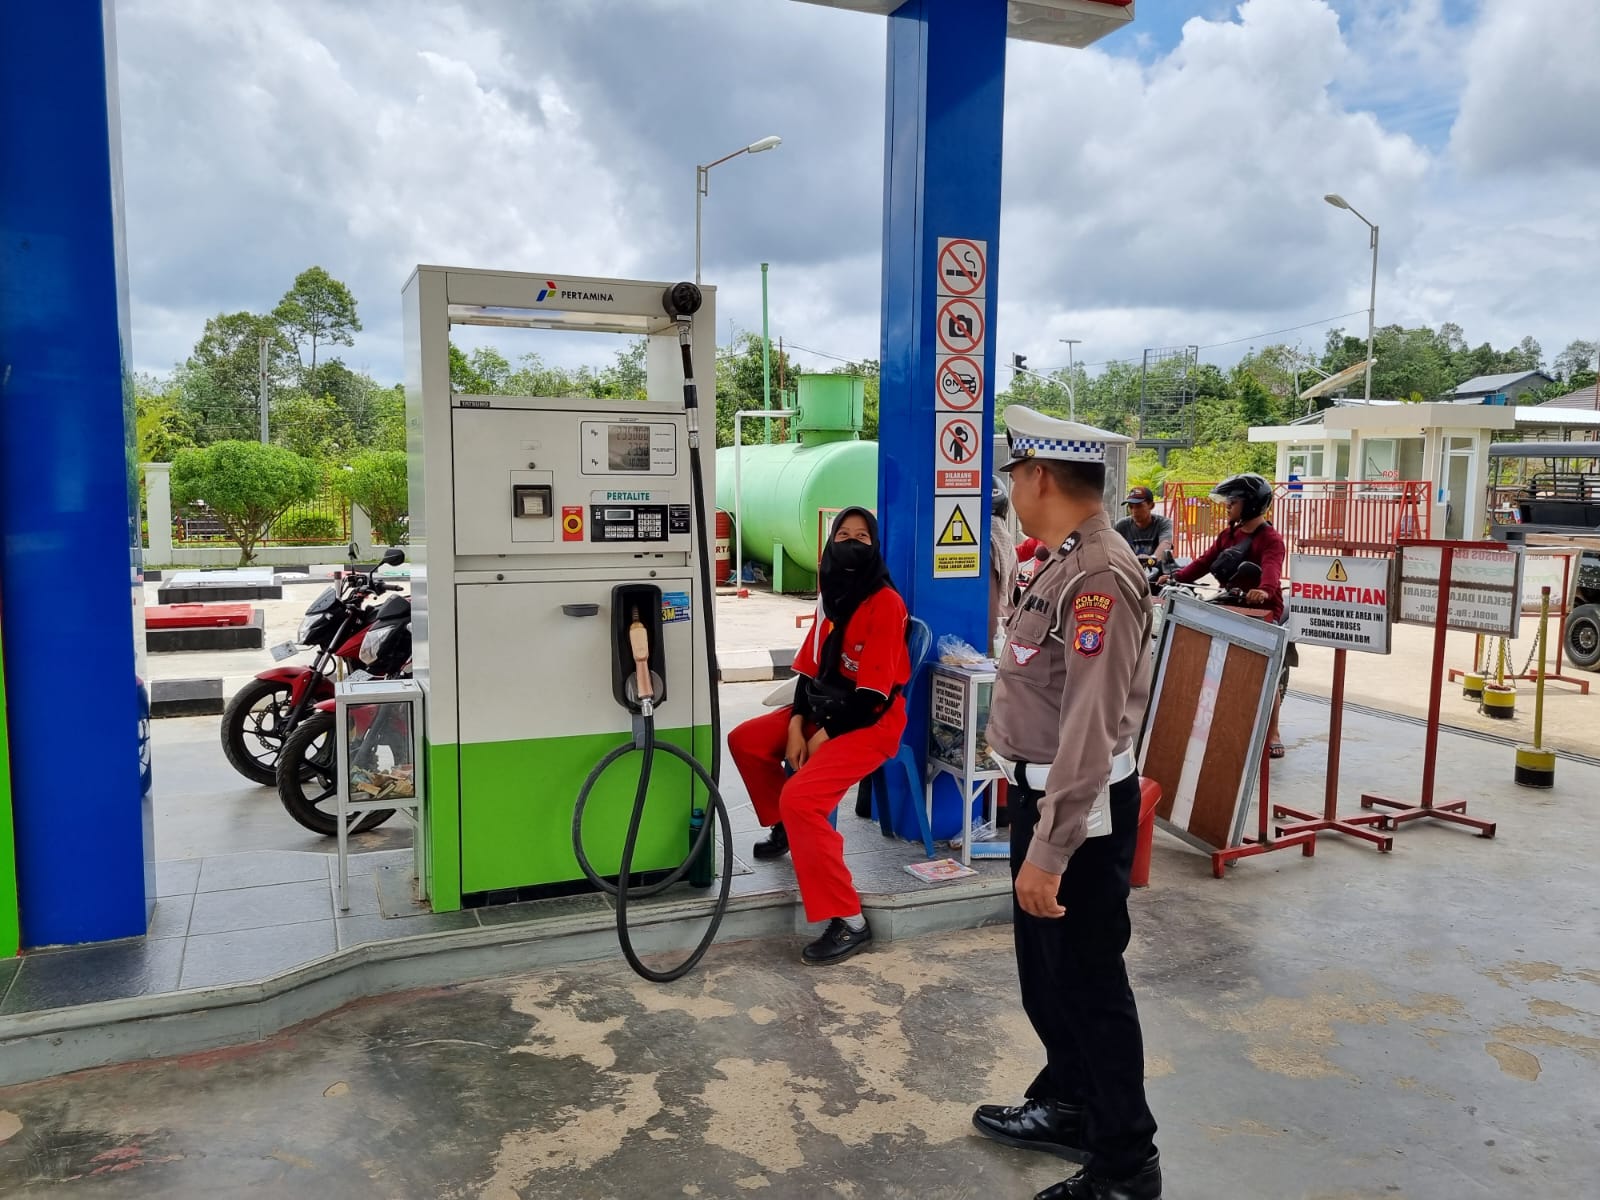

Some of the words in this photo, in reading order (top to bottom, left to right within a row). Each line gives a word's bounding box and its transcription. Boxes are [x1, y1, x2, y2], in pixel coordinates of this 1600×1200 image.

[561, 290, 614, 302] PERTAMINA
[945, 378, 958, 387] ON
[607, 492, 650, 501] PERTALITE
[1075, 595, 1110, 605] POLRES
[1291, 582, 1385, 606] PERHATIAN
[1291, 604, 1321, 614] DILARANG
[1321, 608, 1345, 618] MASUK
[1346, 610, 1354, 619] KE
[1355, 611, 1371, 620] AREA
[1373, 613, 1383, 622] INI
[1310, 618, 1334, 628] SEDANG
[1336, 621, 1361, 631] PROSES
[1301, 628, 1353, 641] PEMBONGKARAN
[1354, 634, 1370, 644] BBM
